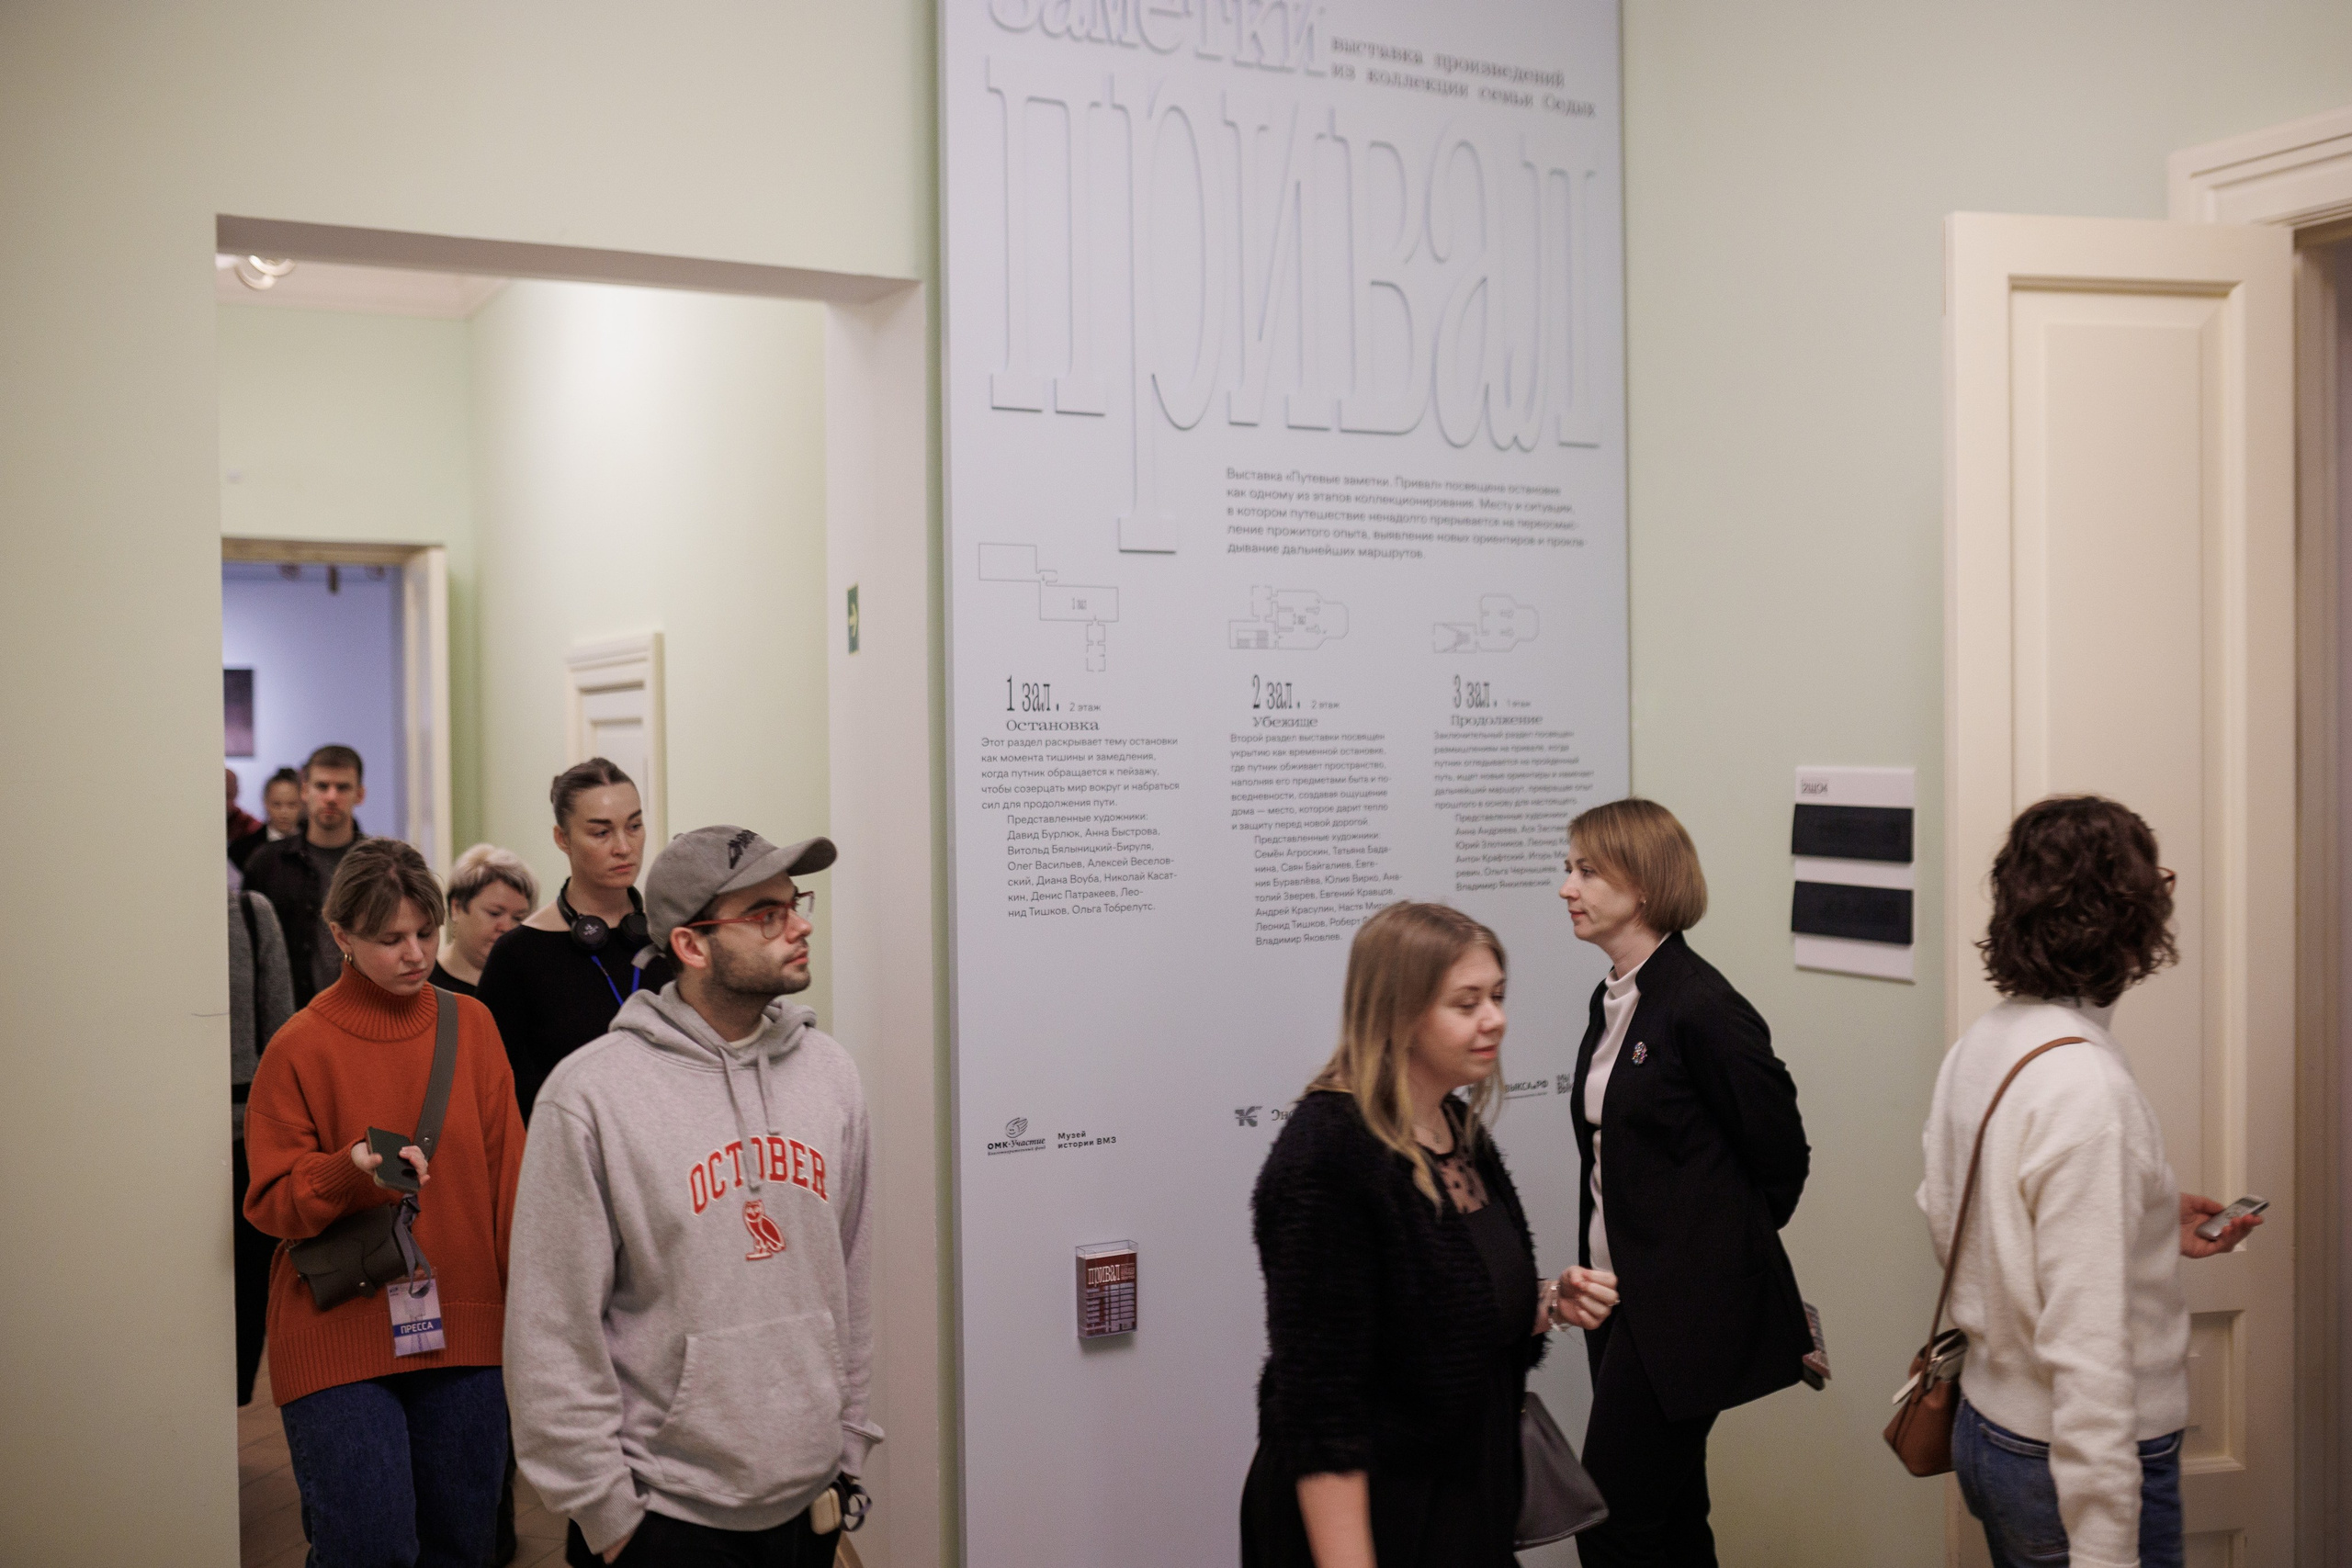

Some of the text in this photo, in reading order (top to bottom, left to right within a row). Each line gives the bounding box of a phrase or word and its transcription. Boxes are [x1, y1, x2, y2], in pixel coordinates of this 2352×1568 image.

[986, 57, 1600, 554] привал
[1226, 467, 1283, 481] Выставка
[1285, 470, 1340, 484] «Путевые
[1227, 489, 1246, 498] как
[1249, 490, 1294, 502] одному
[1295, 492, 1310, 501] из
[1312, 492, 1351, 502] этапов
[1227, 507, 1234, 515] в
[1237, 507, 1287, 518] котором
[1290, 509, 1365, 521] путешествие
[1368, 513, 1428, 524] ненадолго
[1227, 525, 1264, 535] ление
[1266, 526, 1330, 537] прожитого
[1373, 531, 1434, 541] выявление
[1227, 544, 1279, 553] дывание
[1281, 546, 1355, 556] дальнейших
[1006, 675, 1102, 712] 1 зал. 2 этаж
[1252, 674, 1261, 709] 2
[1267, 682, 1300, 710] зал.
[1453, 674, 1462, 708] 3
[1006, 719, 1100, 731] Остановка
[1252, 716, 1318, 728] Убежище
[1451, 716, 1543, 728] Продолжение
[981, 737, 1004, 747] Этот
[1007, 739, 1042, 748] раздел
[1045, 739, 1102, 748] раскрывает
[1096, 753, 1157, 761] замедления,
[981, 771, 1009, 779] когда
[1011, 770, 1045, 779] путник
[1047, 768, 1107, 778] обращается
[1116, 767, 1160, 775] пейзажу,
[981, 784, 1012, 794] чтобы
[1013, 784, 1065, 794] созерцать
[1067, 784, 1087, 793] мир
[1089, 784, 1121, 793] вокруг
[1131, 782, 1180, 791] набраться
[1001, 801, 1021, 810] для
[1023, 800, 1091, 809] продолжения
[1092, 799, 1118, 807] пути.
[1007, 814, 1091, 825] Представленные
[1006, 827, 1160, 840] Давид Бурлюк, Анна Быстрова,
[1007, 842, 1154, 855] Витольд Бялыницкий-Бируля,
[1007, 856, 1174, 871] Олег Васильев, Алексей Веселов-
[1007, 872, 1178, 886] ский, Диана Воуба, Николай Касат-
[1030, 891, 1062, 902] Денис
[1064, 889, 1119, 899] Патракеев,
[1121, 886, 1144, 897] Лео-
[1008, 903, 1156, 918] нид Тишков, Ольга Тобрелутс.
[1057, 1131, 1086, 1140] Музей
[1057, 1136, 1117, 1149] истории ВМЗ
[1088, 1264, 1120, 1286] привал
[401, 1322, 434, 1334] ПРЕССА
